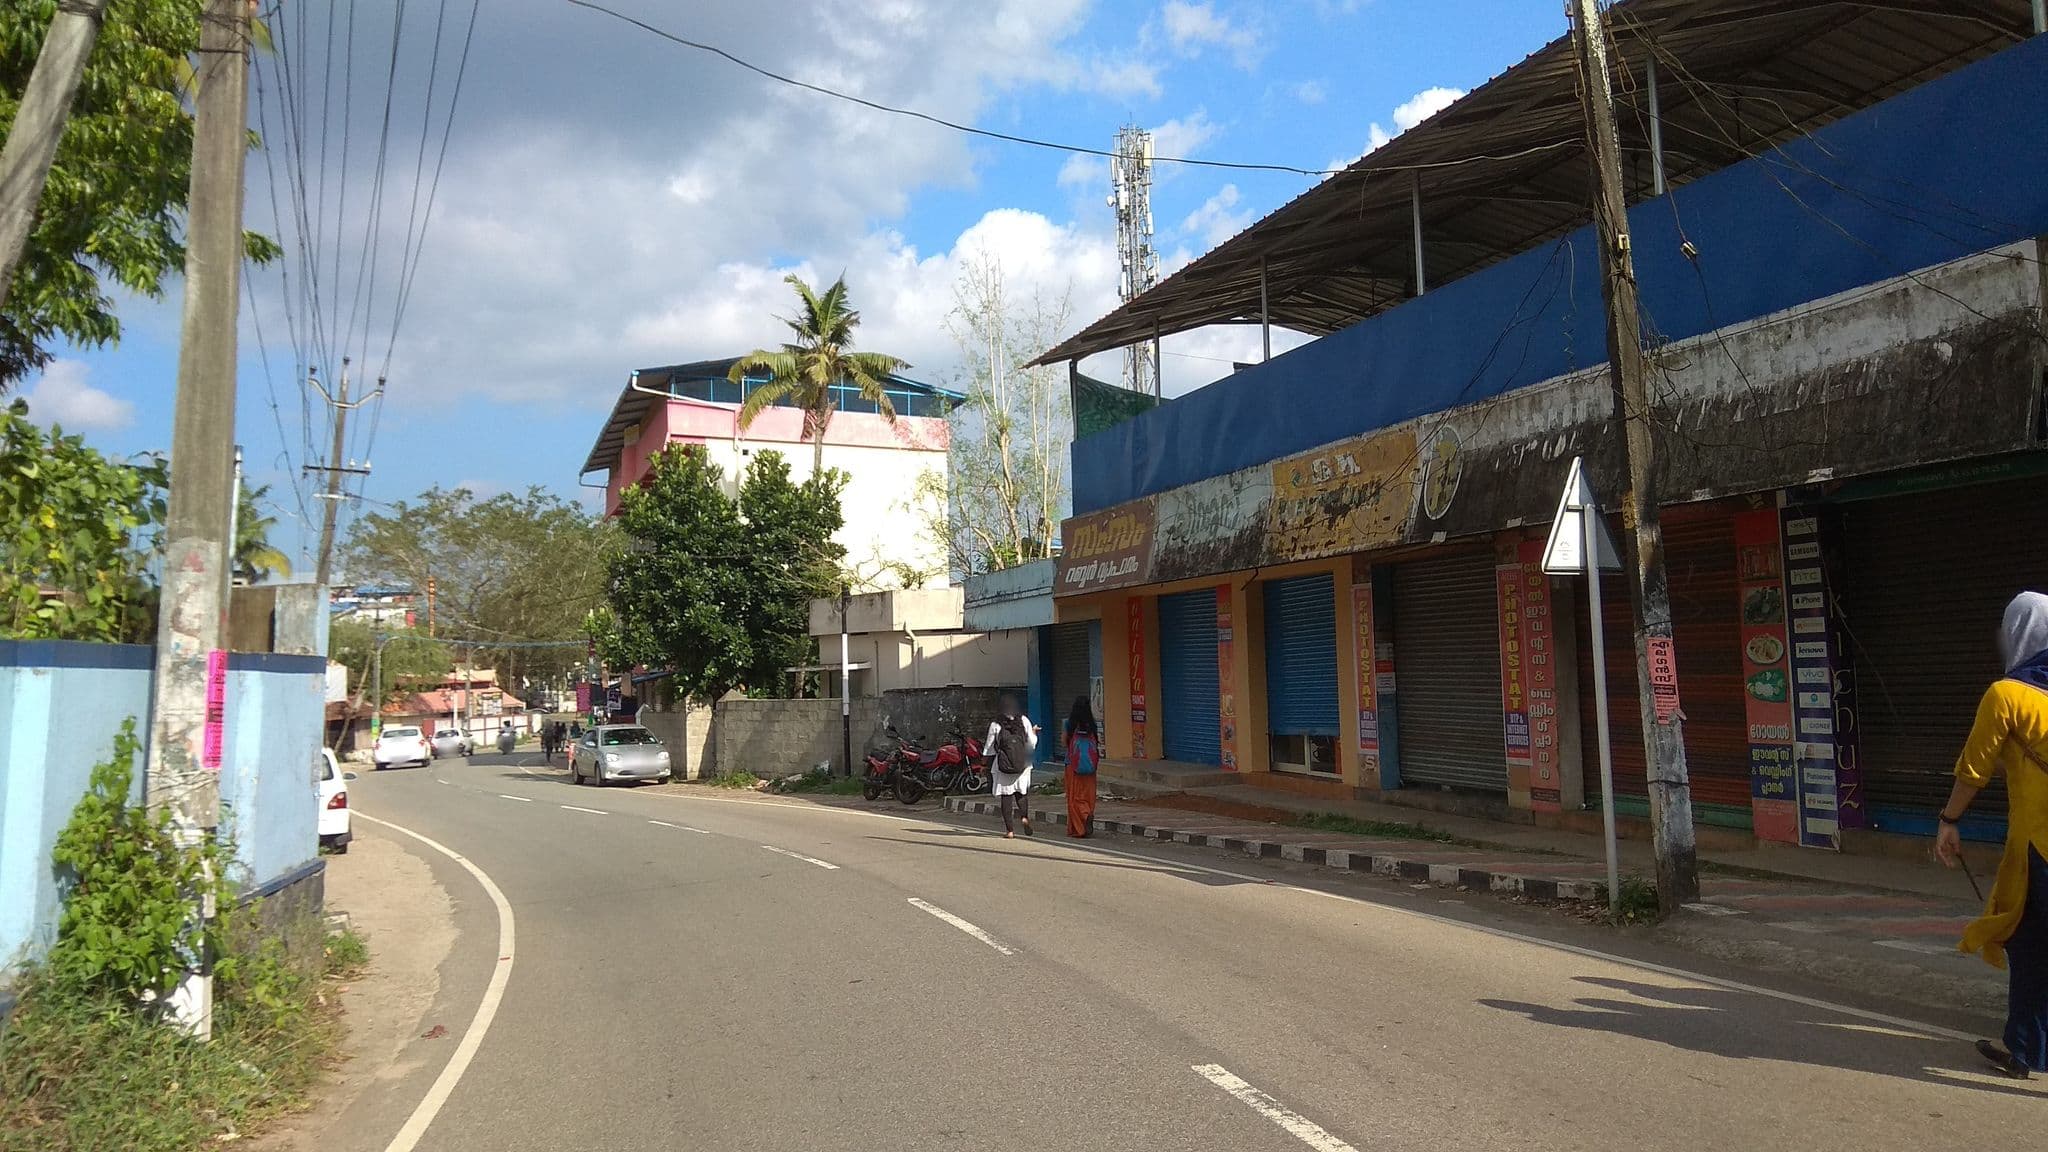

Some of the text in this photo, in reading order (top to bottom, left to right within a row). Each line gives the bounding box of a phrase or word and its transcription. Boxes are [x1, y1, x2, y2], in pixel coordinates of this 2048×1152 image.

[1790, 544, 1818, 556] SAMSUNG
[1503, 583, 1522, 710] PHOTOSTAT
[1798, 645, 1824, 655] lenovo
[1358, 600, 1372, 708] PHOTOSTAT
[1801, 670, 1824, 678] vivo
